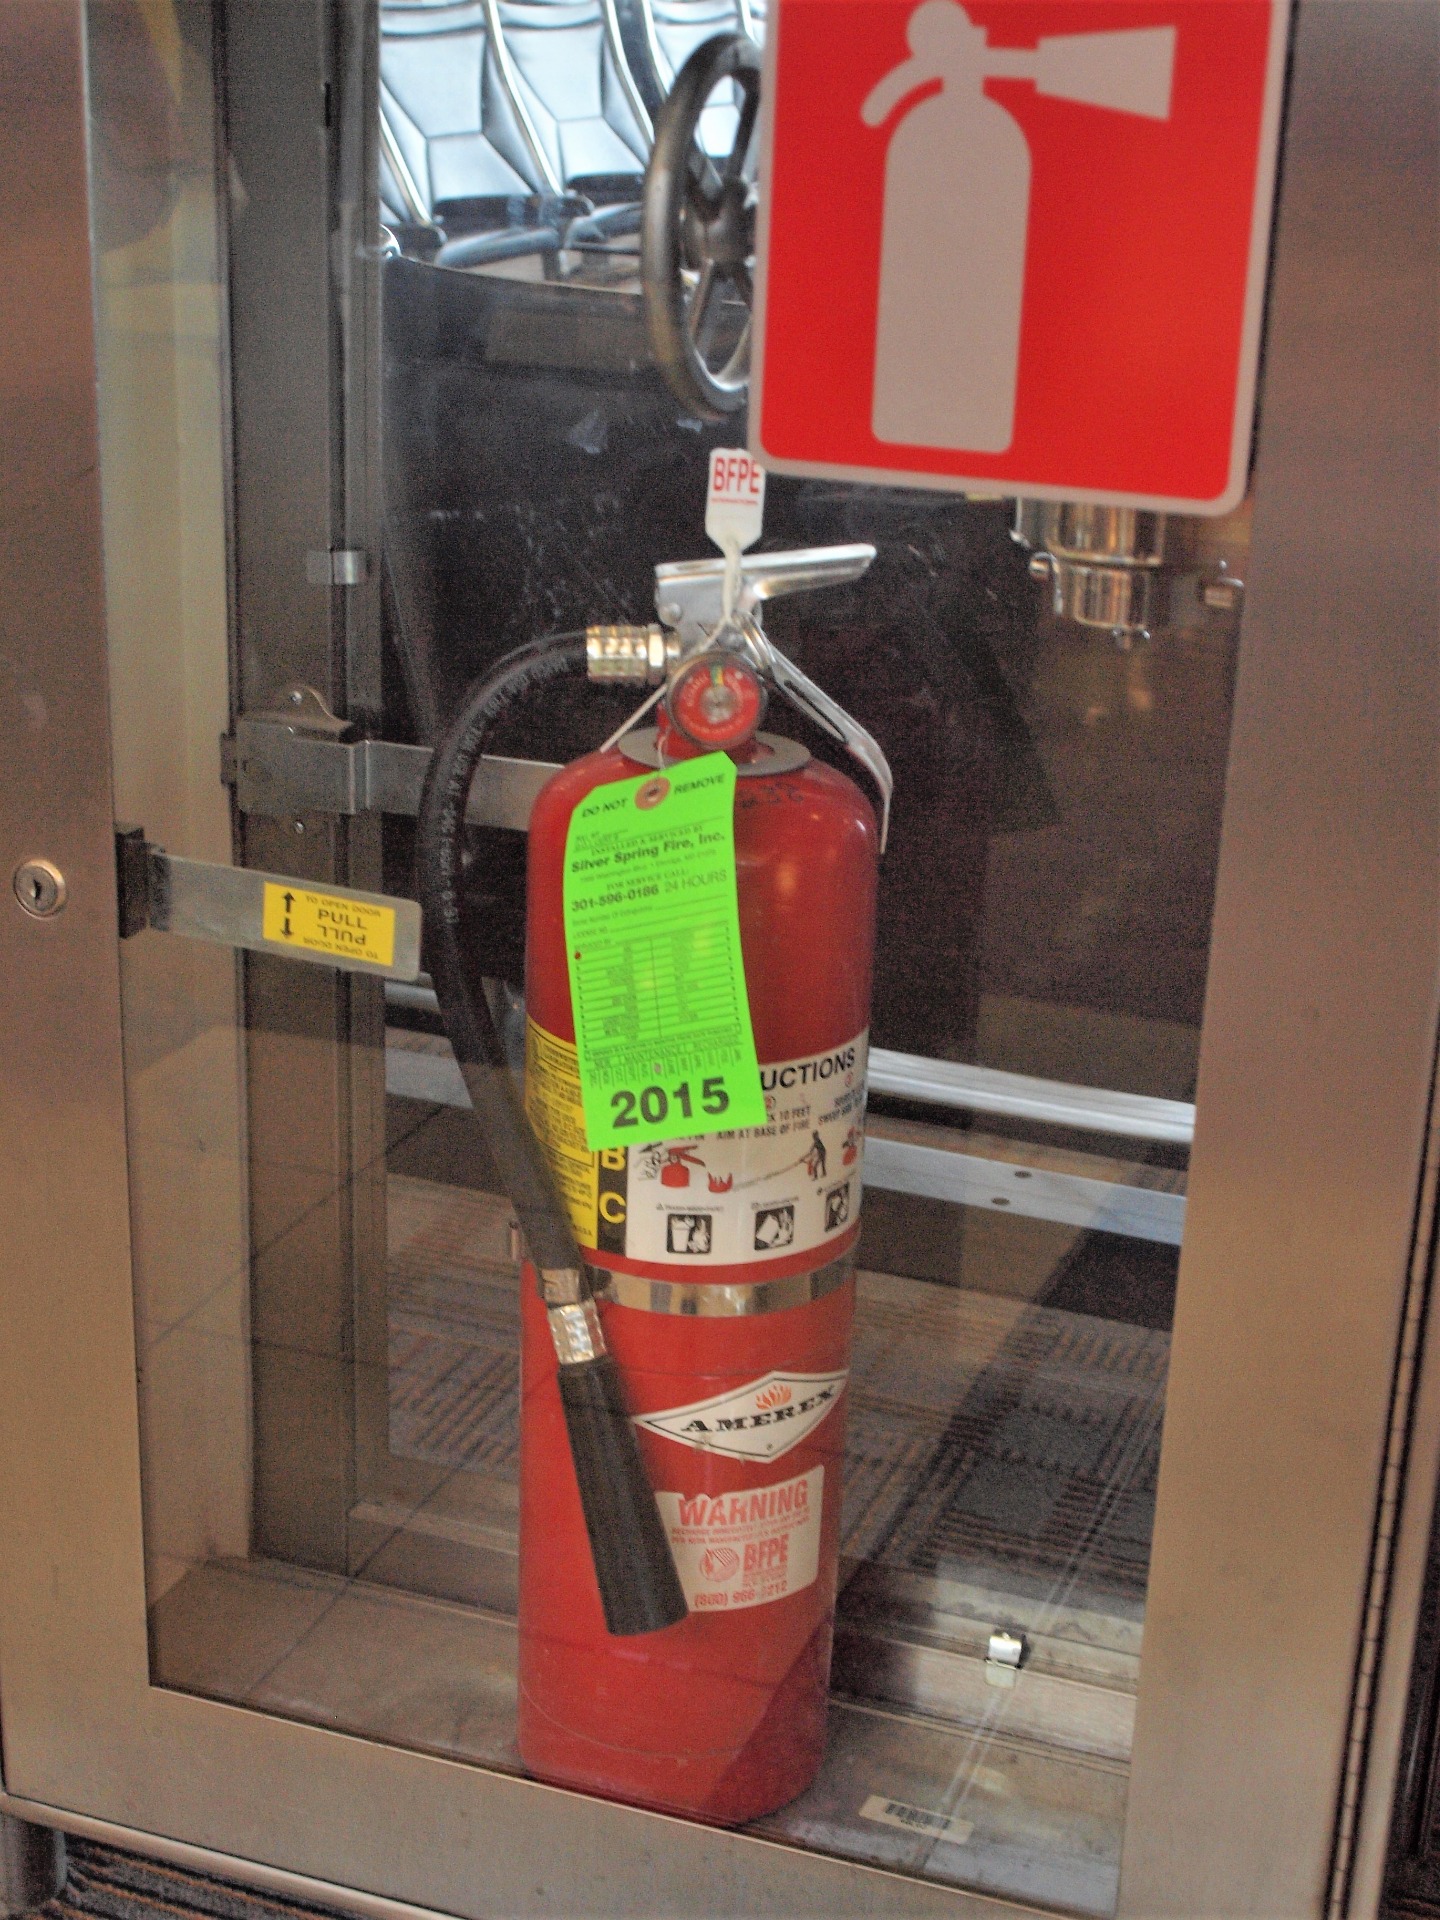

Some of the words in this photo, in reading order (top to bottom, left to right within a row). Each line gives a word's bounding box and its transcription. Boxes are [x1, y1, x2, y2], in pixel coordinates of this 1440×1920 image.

[713, 457, 760, 493] BFPE
[582, 804, 602, 818] DO
[603, 798, 628, 814] NOT
[674, 774, 726, 794] REMOVE
[571, 857, 610, 873] Silver
[614, 844, 660, 865] Spring
[663, 838, 695, 853] Fire,
[698, 831, 726, 845] Inc.
[664, 878, 679, 895] 24
[681, 869, 728, 891] HOURS
[317, 908, 368, 930] PULL
[321, 898, 348, 910] OPEN
[316, 924, 367, 946] PULL
[610, 1076, 730, 1129] 2015
[792, 1105, 811, 1119] FEET
[717, 1129, 735, 1140] AIM
[738, 1128, 750, 1139] AT
[754, 1125, 777, 1138] BASE
[779, 1123, 791, 1135] OF
[599, 1191, 627, 1224] C
[681, 1385, 835, 1433] AMEREX
[678, 1479, 808, 1526] WARNING
[743, 1533, 789, 1572] BFPE
